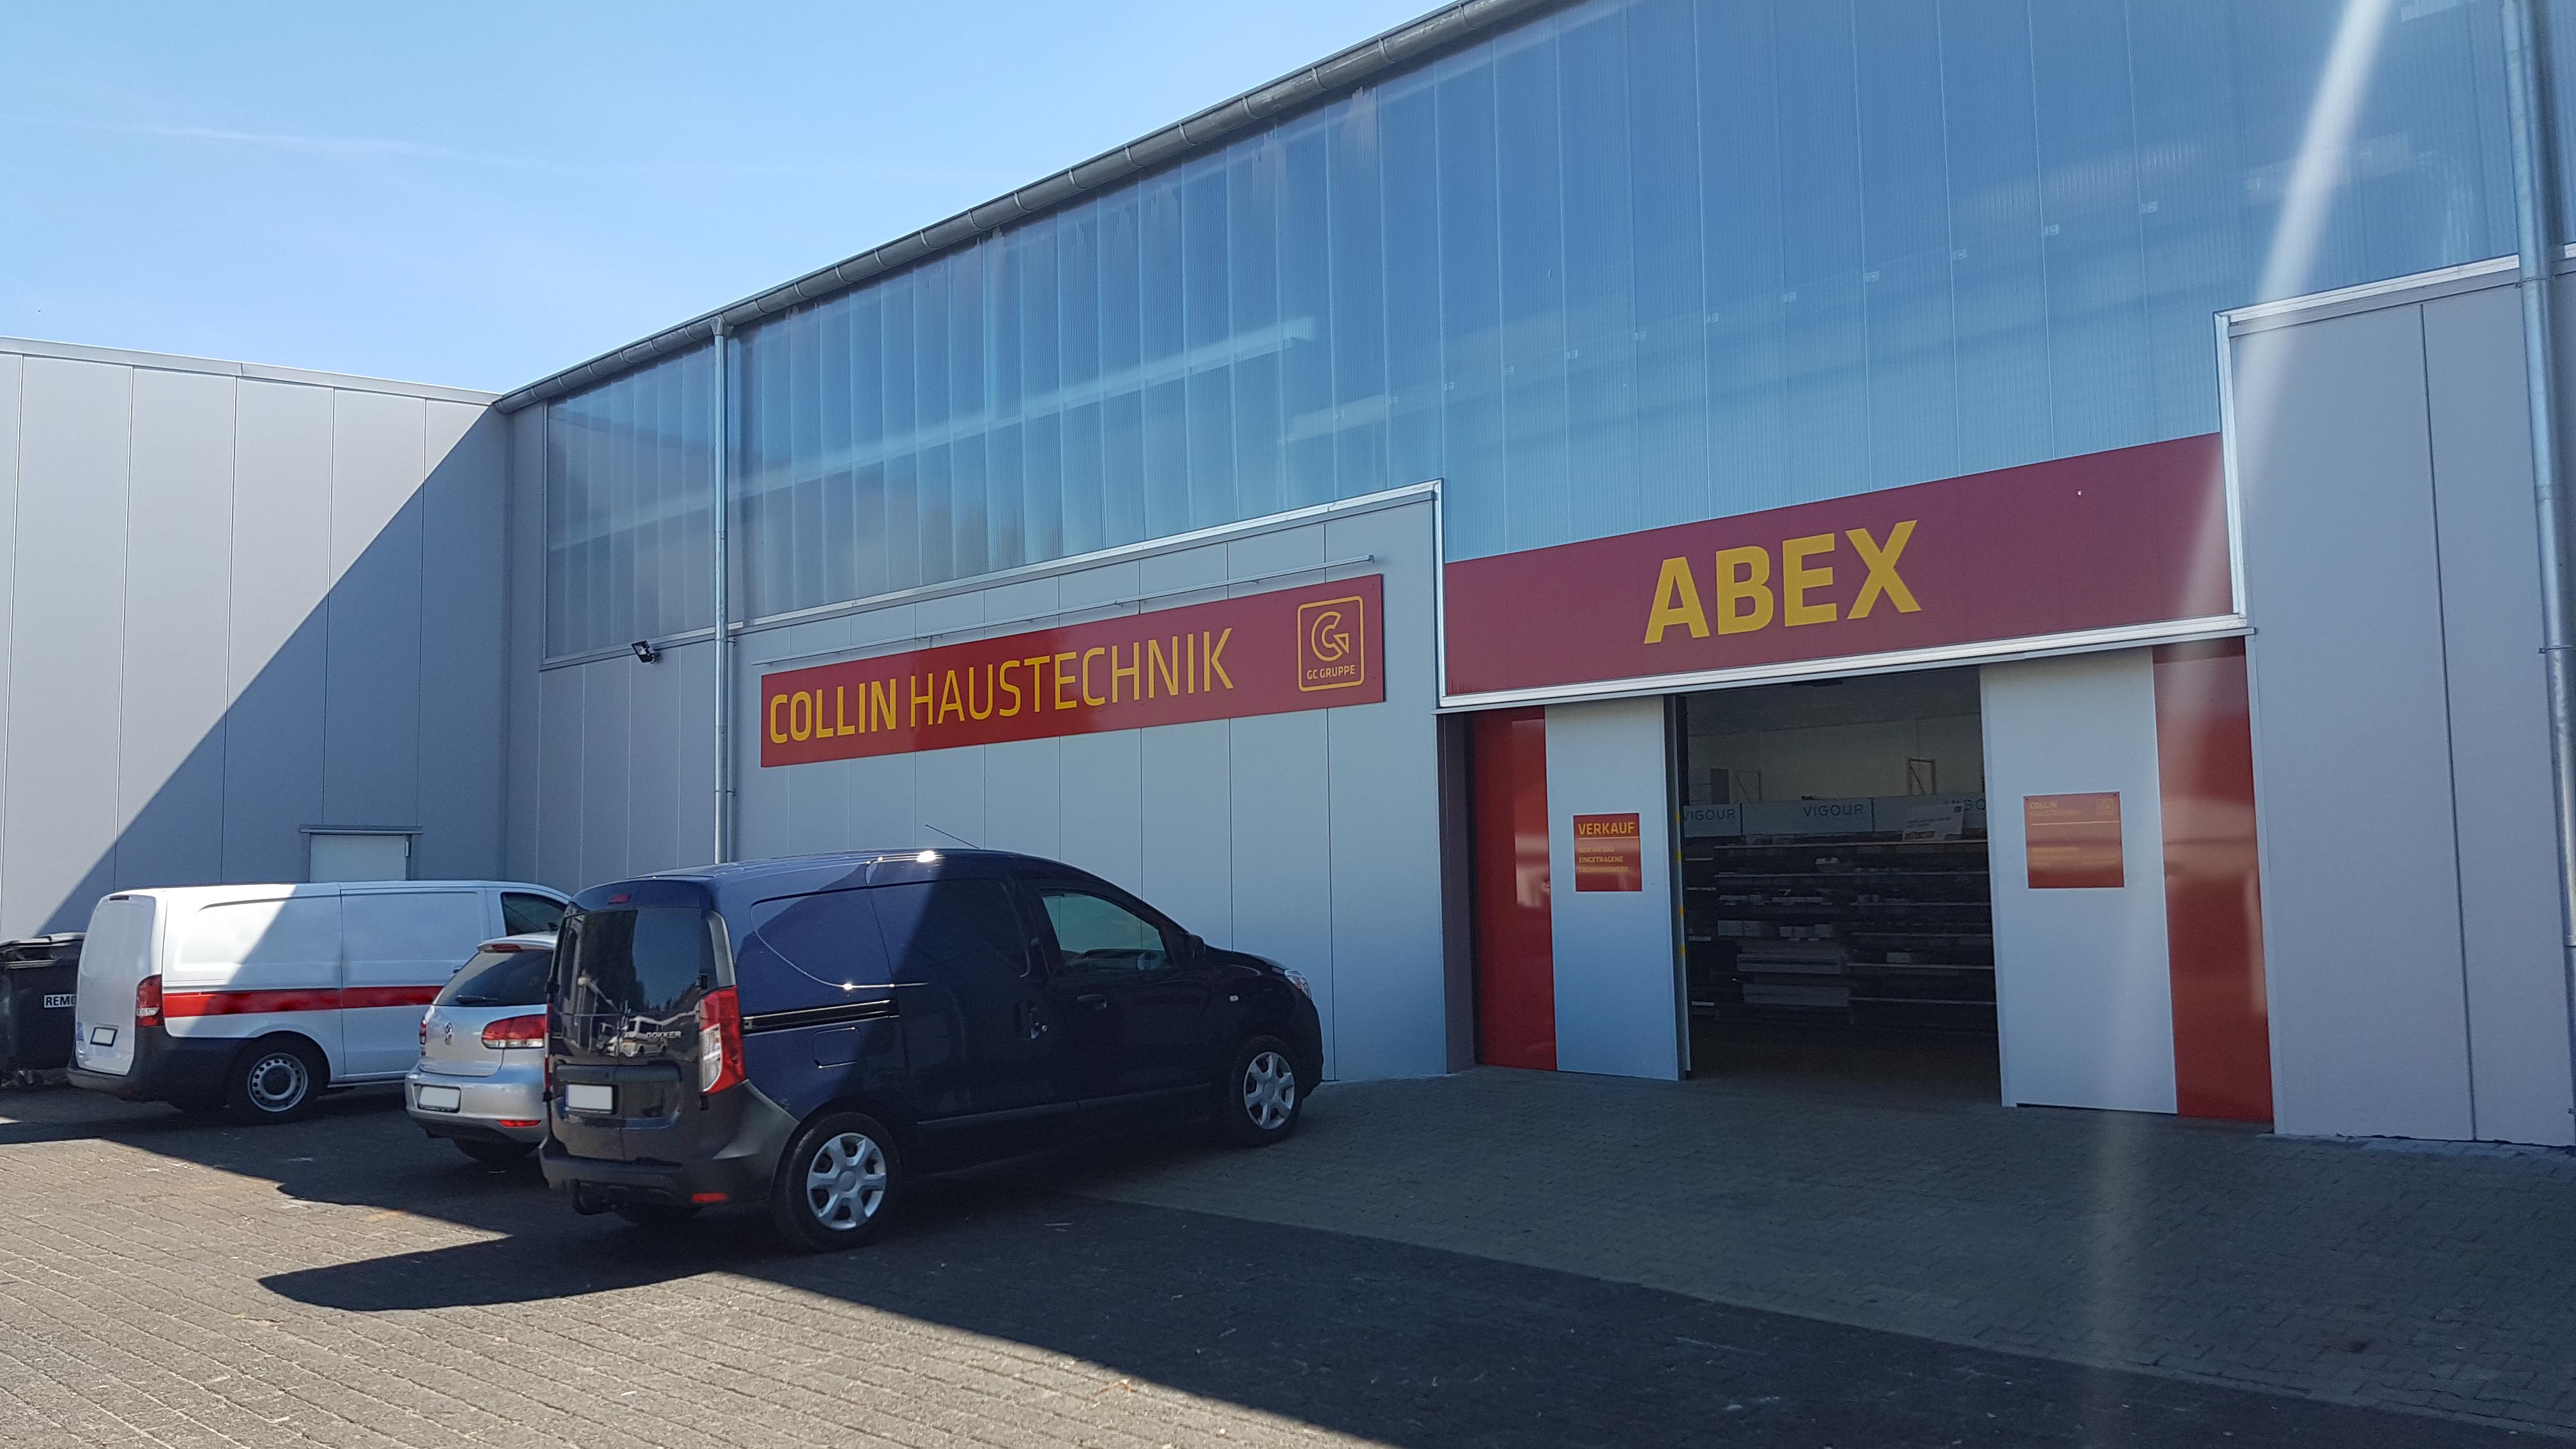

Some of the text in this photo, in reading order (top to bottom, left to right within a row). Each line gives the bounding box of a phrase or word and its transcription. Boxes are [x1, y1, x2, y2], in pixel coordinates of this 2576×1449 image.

[1644, 519, 1922, 645] ABEX
[1307, 664, 1355, 680] GC GRUPPE
[769, 627, 1234, 744] COLLIN HAUSTECHNIK
[1683, 808, 1736, 821] VIGOUR
[1804, 804, 1864, 817] VIGOUR
[1578, 822, 1634, 834] VERKAUF
